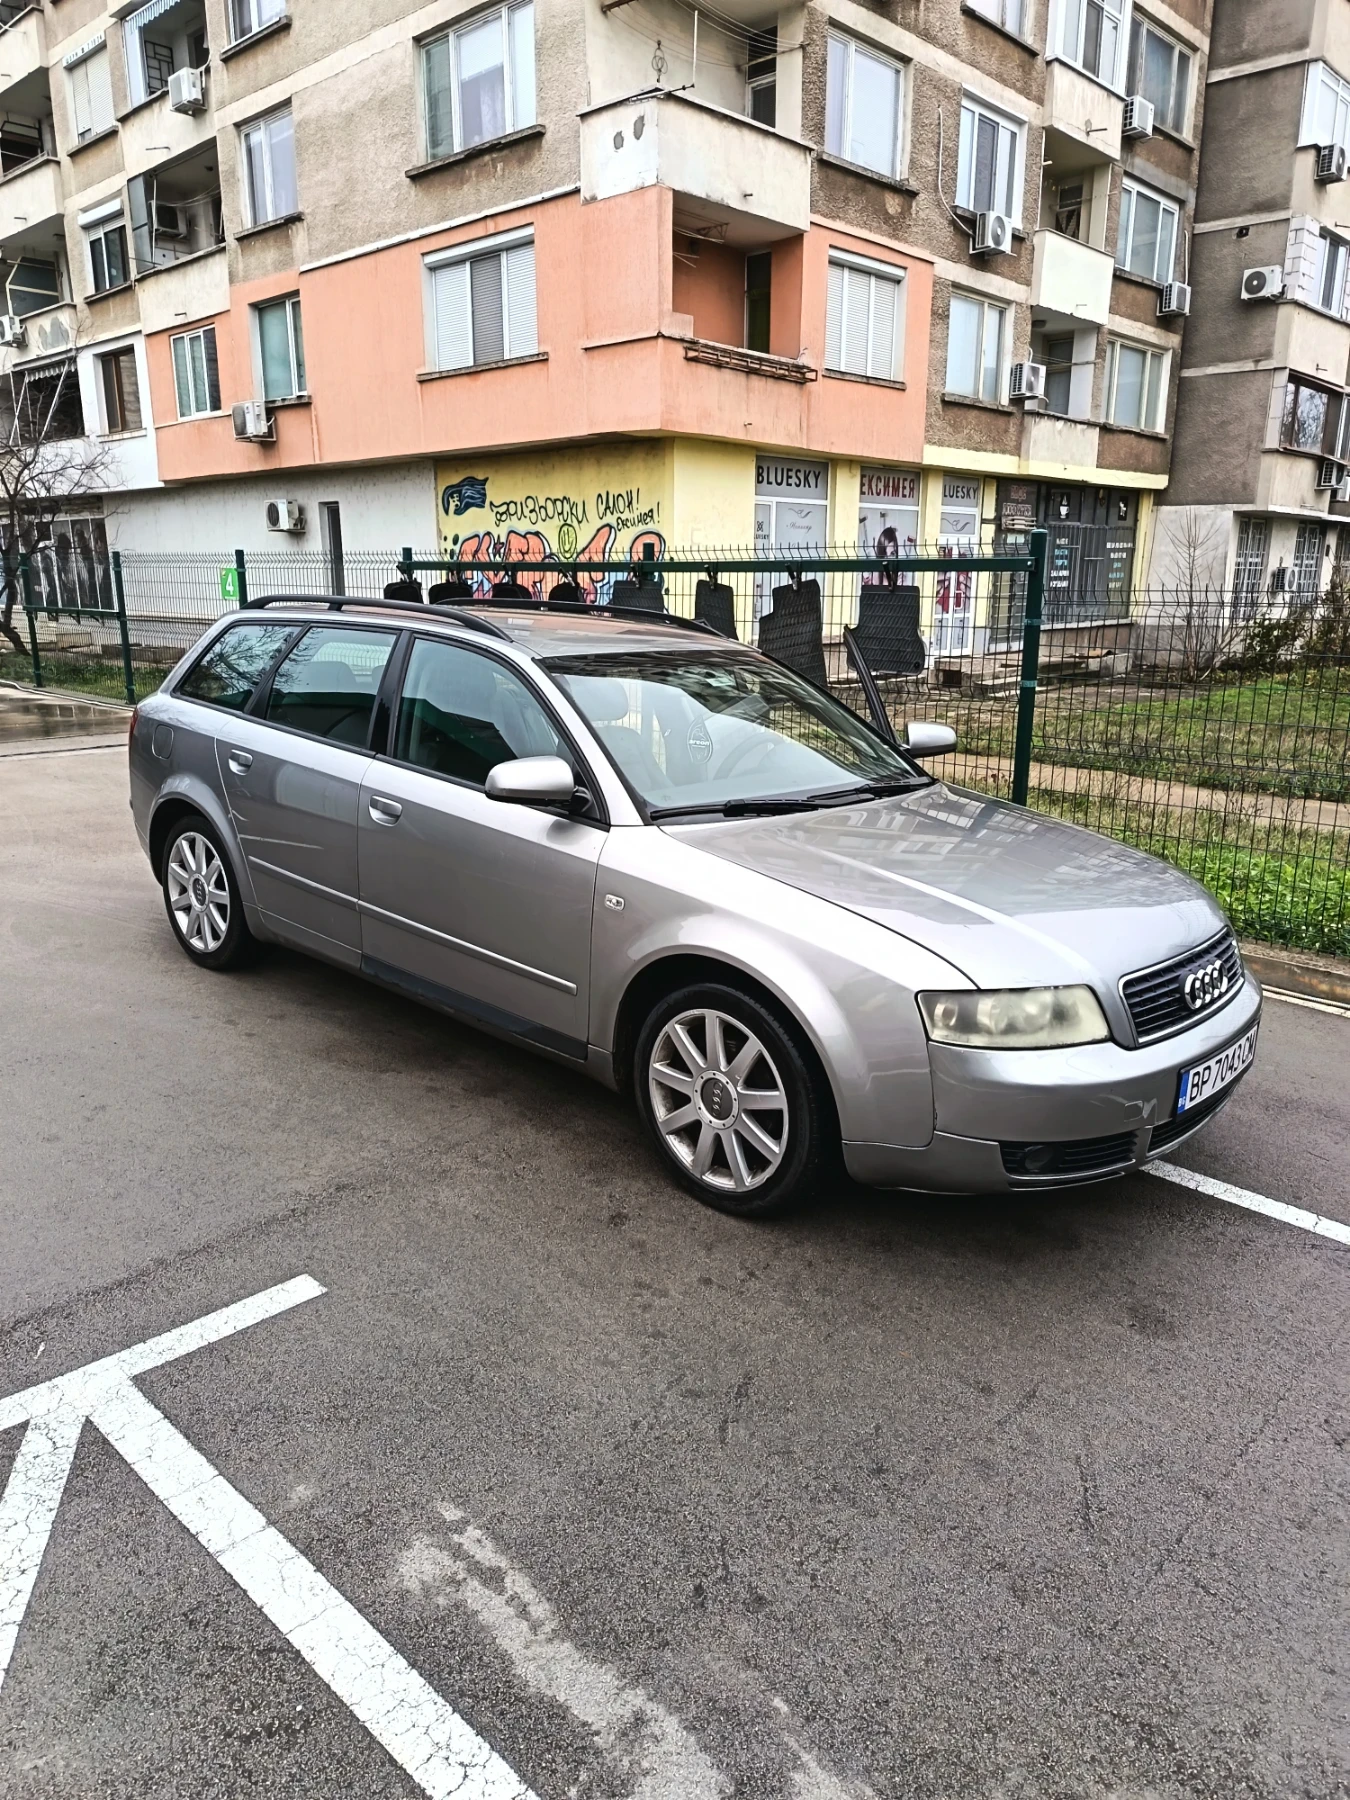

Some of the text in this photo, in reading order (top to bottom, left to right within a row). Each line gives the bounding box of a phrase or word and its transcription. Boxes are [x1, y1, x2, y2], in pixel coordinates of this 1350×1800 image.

[756, 465, 821, 489] BLUESKY
[860, 474, 916, 499] ЕКСИМЕЯ
[943, 484, 979, 500] LUESKY
[225, 572, 234, 596] 4
[1189, 1064, 1212, 1103] BP
[1211, 1043, 1242, 1089] 7043
